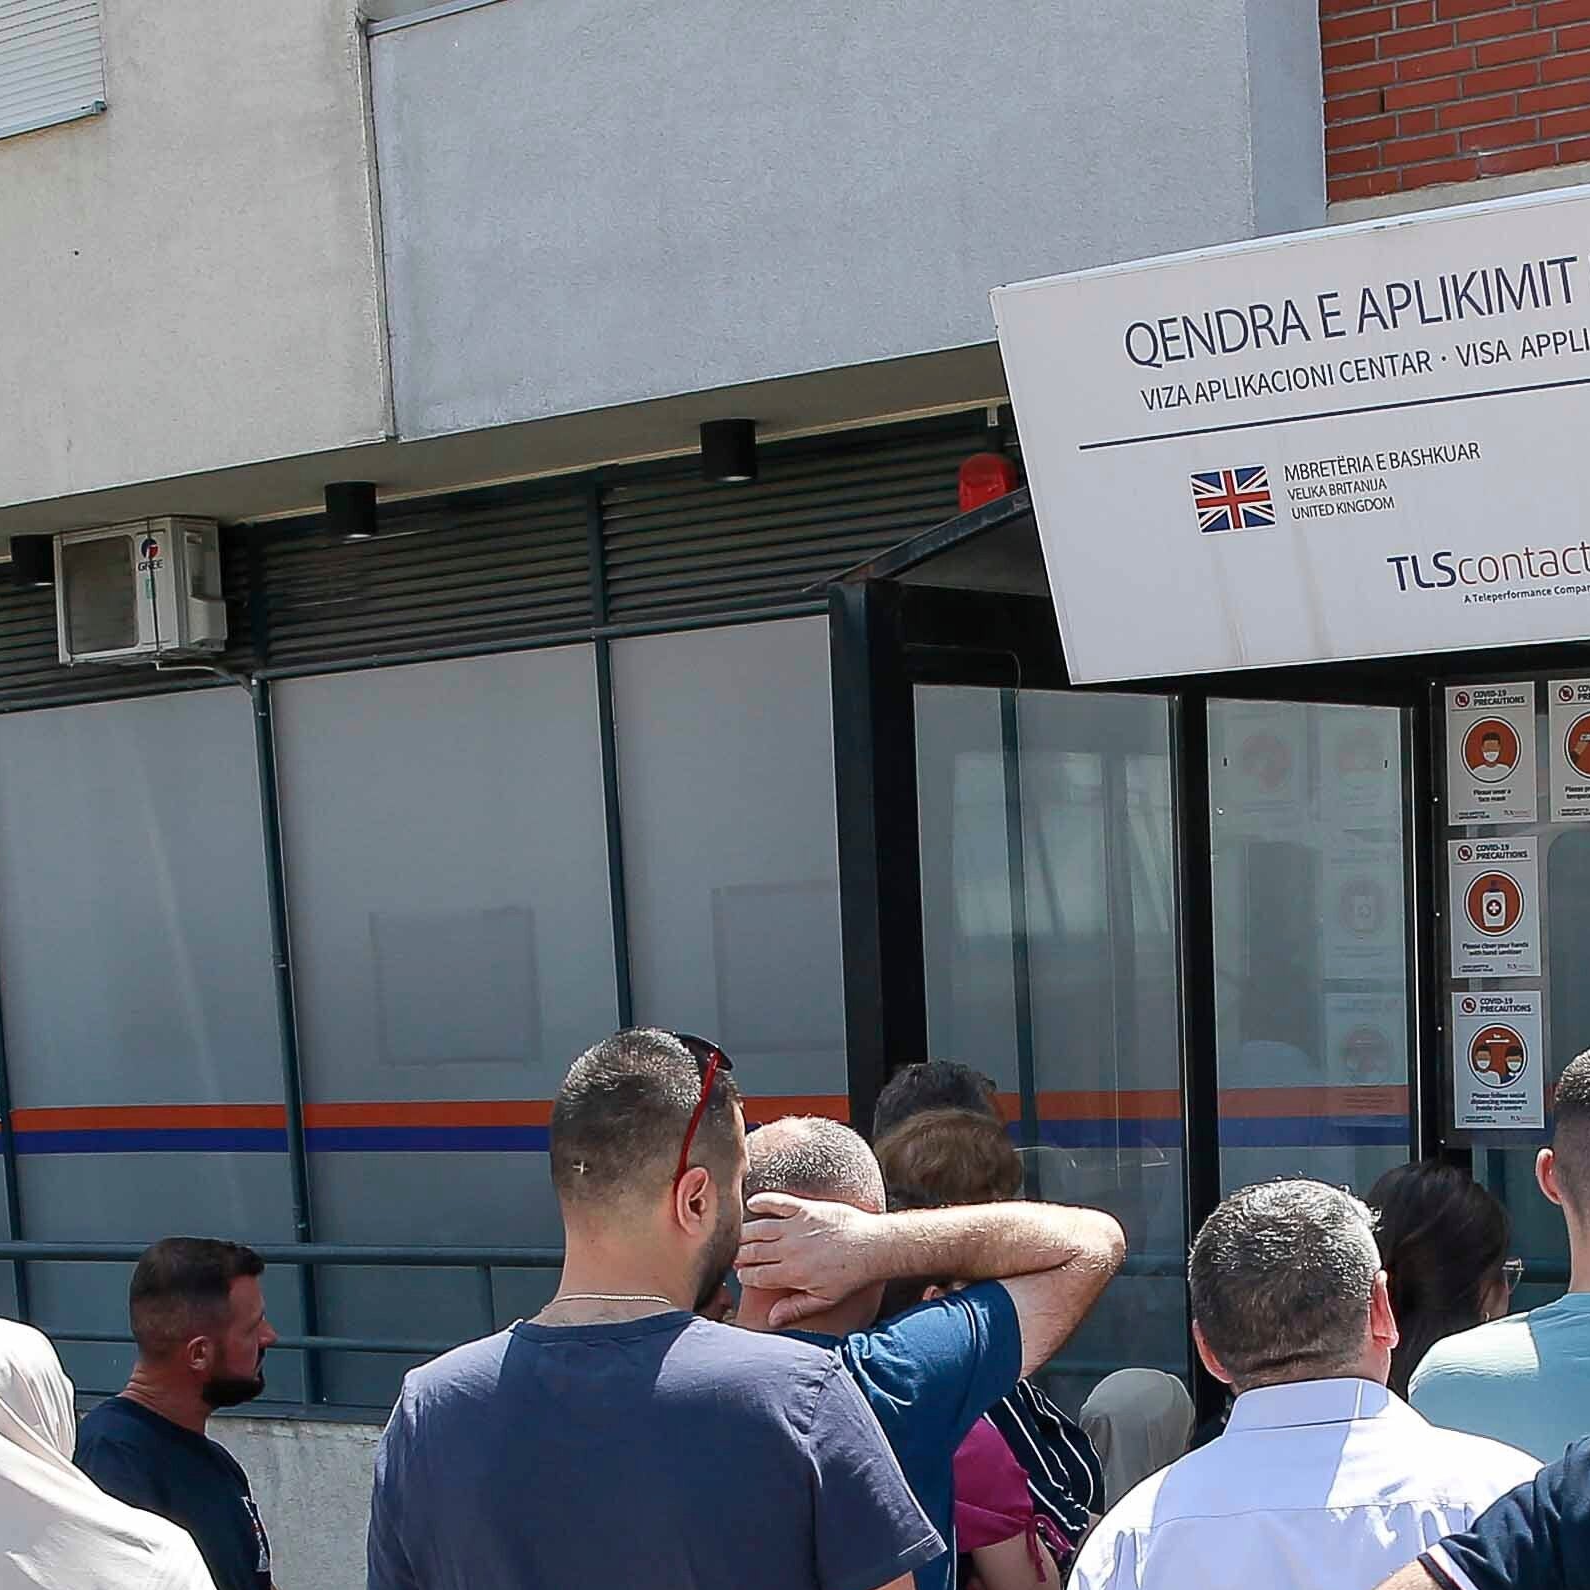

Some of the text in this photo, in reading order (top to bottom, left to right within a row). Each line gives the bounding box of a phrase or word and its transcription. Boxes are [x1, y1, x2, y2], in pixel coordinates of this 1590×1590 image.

[1125, 299, 1311, 368] QENDRA
[1317, 291, 1346, 338] E
[1358, 256, 1578, 334] APLIKIMIT
[1140, 384, 1192, 410] VIZA
[1195, 363, 1335, 403] APLIKACIONI
[1339, 350, 1432, 383] CENTAR
[1456, 340, 1512, 367] VISA
[1284, 442, 1481, 482] MBRETËRIA E BASHKUAR
[1287, 477, 1387, 501] VELIKA BRITANIJA
[1291, 496, 1395, 520] UNITED KINGDOM
[1464, 594, 1472, 604] A
[1472, 586, 1552, 603] Teleperformance
[1473, 689, 1507, 698] COVID-19
[1474, 696, 1525, 706] PRECAUTIONS
[1476, 850, 1528, 859] PRECAUTIONS
[1480, 1004, 1531, 1013] PRECAUTIONS
